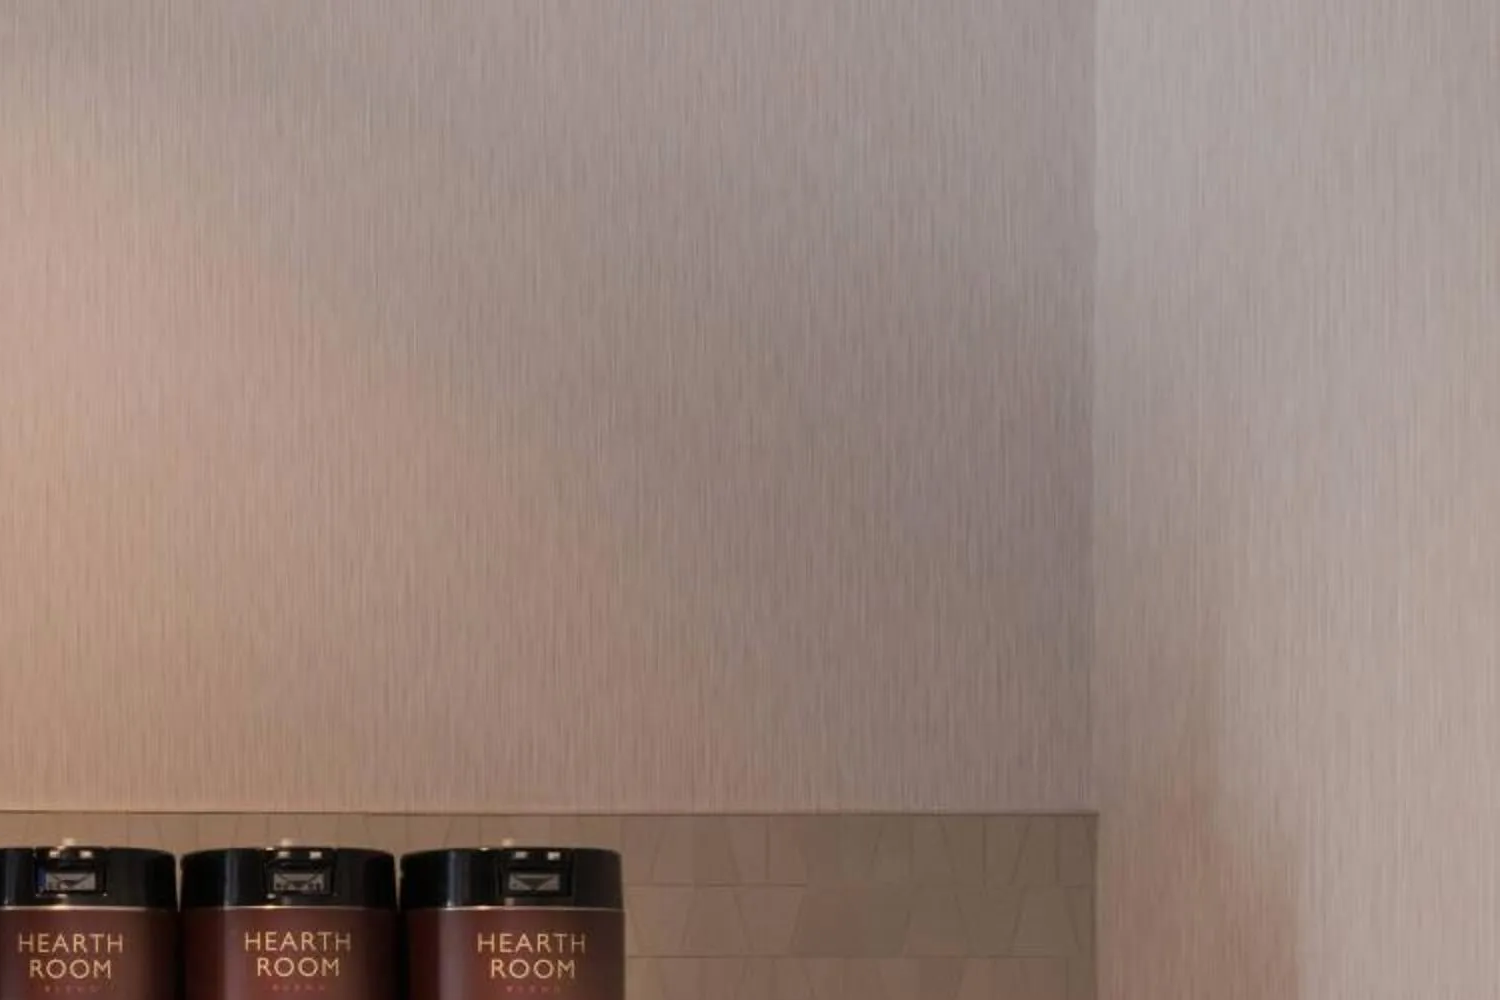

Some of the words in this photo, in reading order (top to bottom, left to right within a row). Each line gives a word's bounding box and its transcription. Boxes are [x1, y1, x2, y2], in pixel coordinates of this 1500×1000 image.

[18, 933, 124, 953] HEARTH
[244, 931, 351, 952] HEARTH
[477, 933, 586, 953] HEARTH
[29, 959, 112, 979] ROOM
[256, 957, 340, 977] ROOM
[490, 959, 575, 979] ROOM
